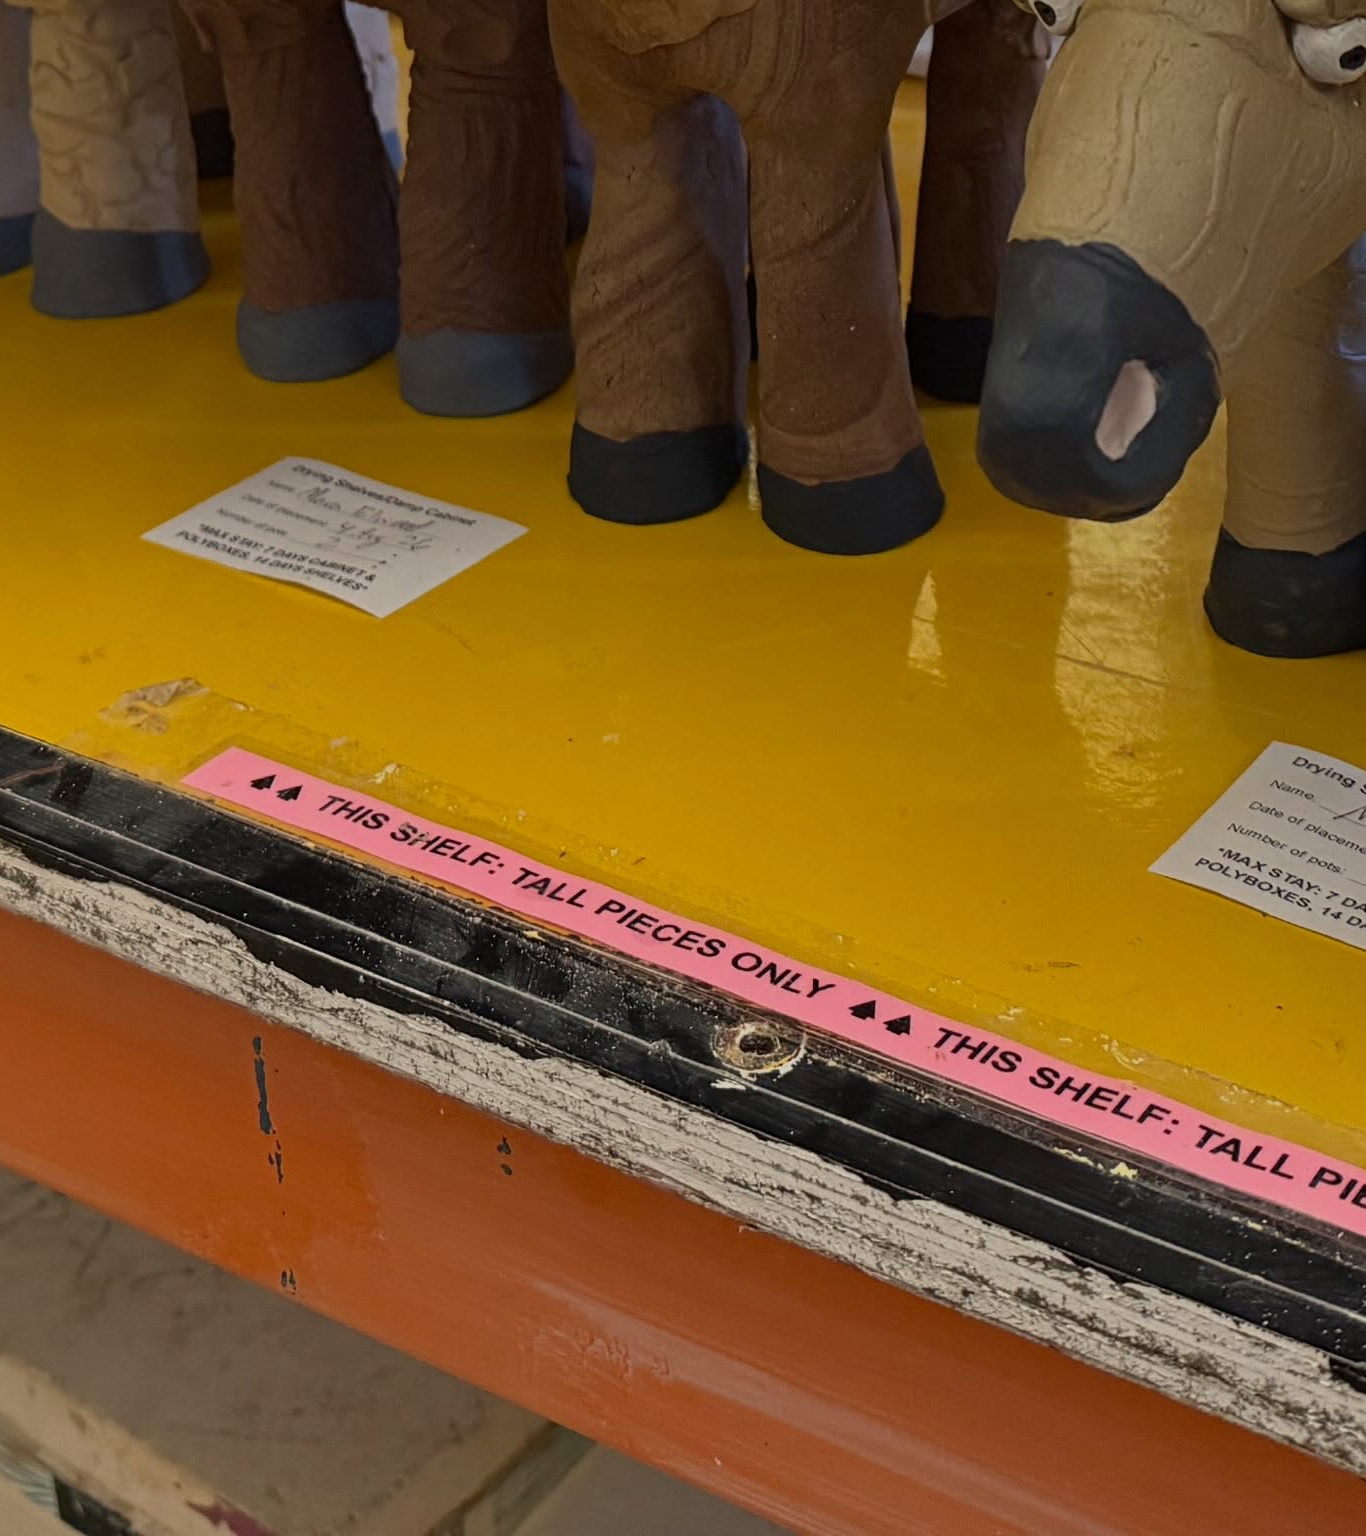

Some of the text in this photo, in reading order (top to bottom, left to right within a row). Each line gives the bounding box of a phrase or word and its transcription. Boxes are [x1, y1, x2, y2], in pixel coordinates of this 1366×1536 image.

[1292, 756, 1357, 788] Drying
[1248, 801, 1284, 818] Date
[1287, 815, 1307, 826] of
[1227, 822, 1288, 850] Number
[1290, 847, 1310, 859] of
[318, 795, 836, 999] THIS SHELF: TALL PIECES ONLY
[1195, 857, 1313, 912] POLYBOXES,
[1322, 907, 1344, 920] 14
[1268, 867, 1322, 895] STAY:
[1326, 890, 1340, 900] 7
[933, 1027, 1022, 1073] THIS
[1029, 1066, 1180, 1135] SHELF:
[1194, 1124, 1295, 1180] TALL
